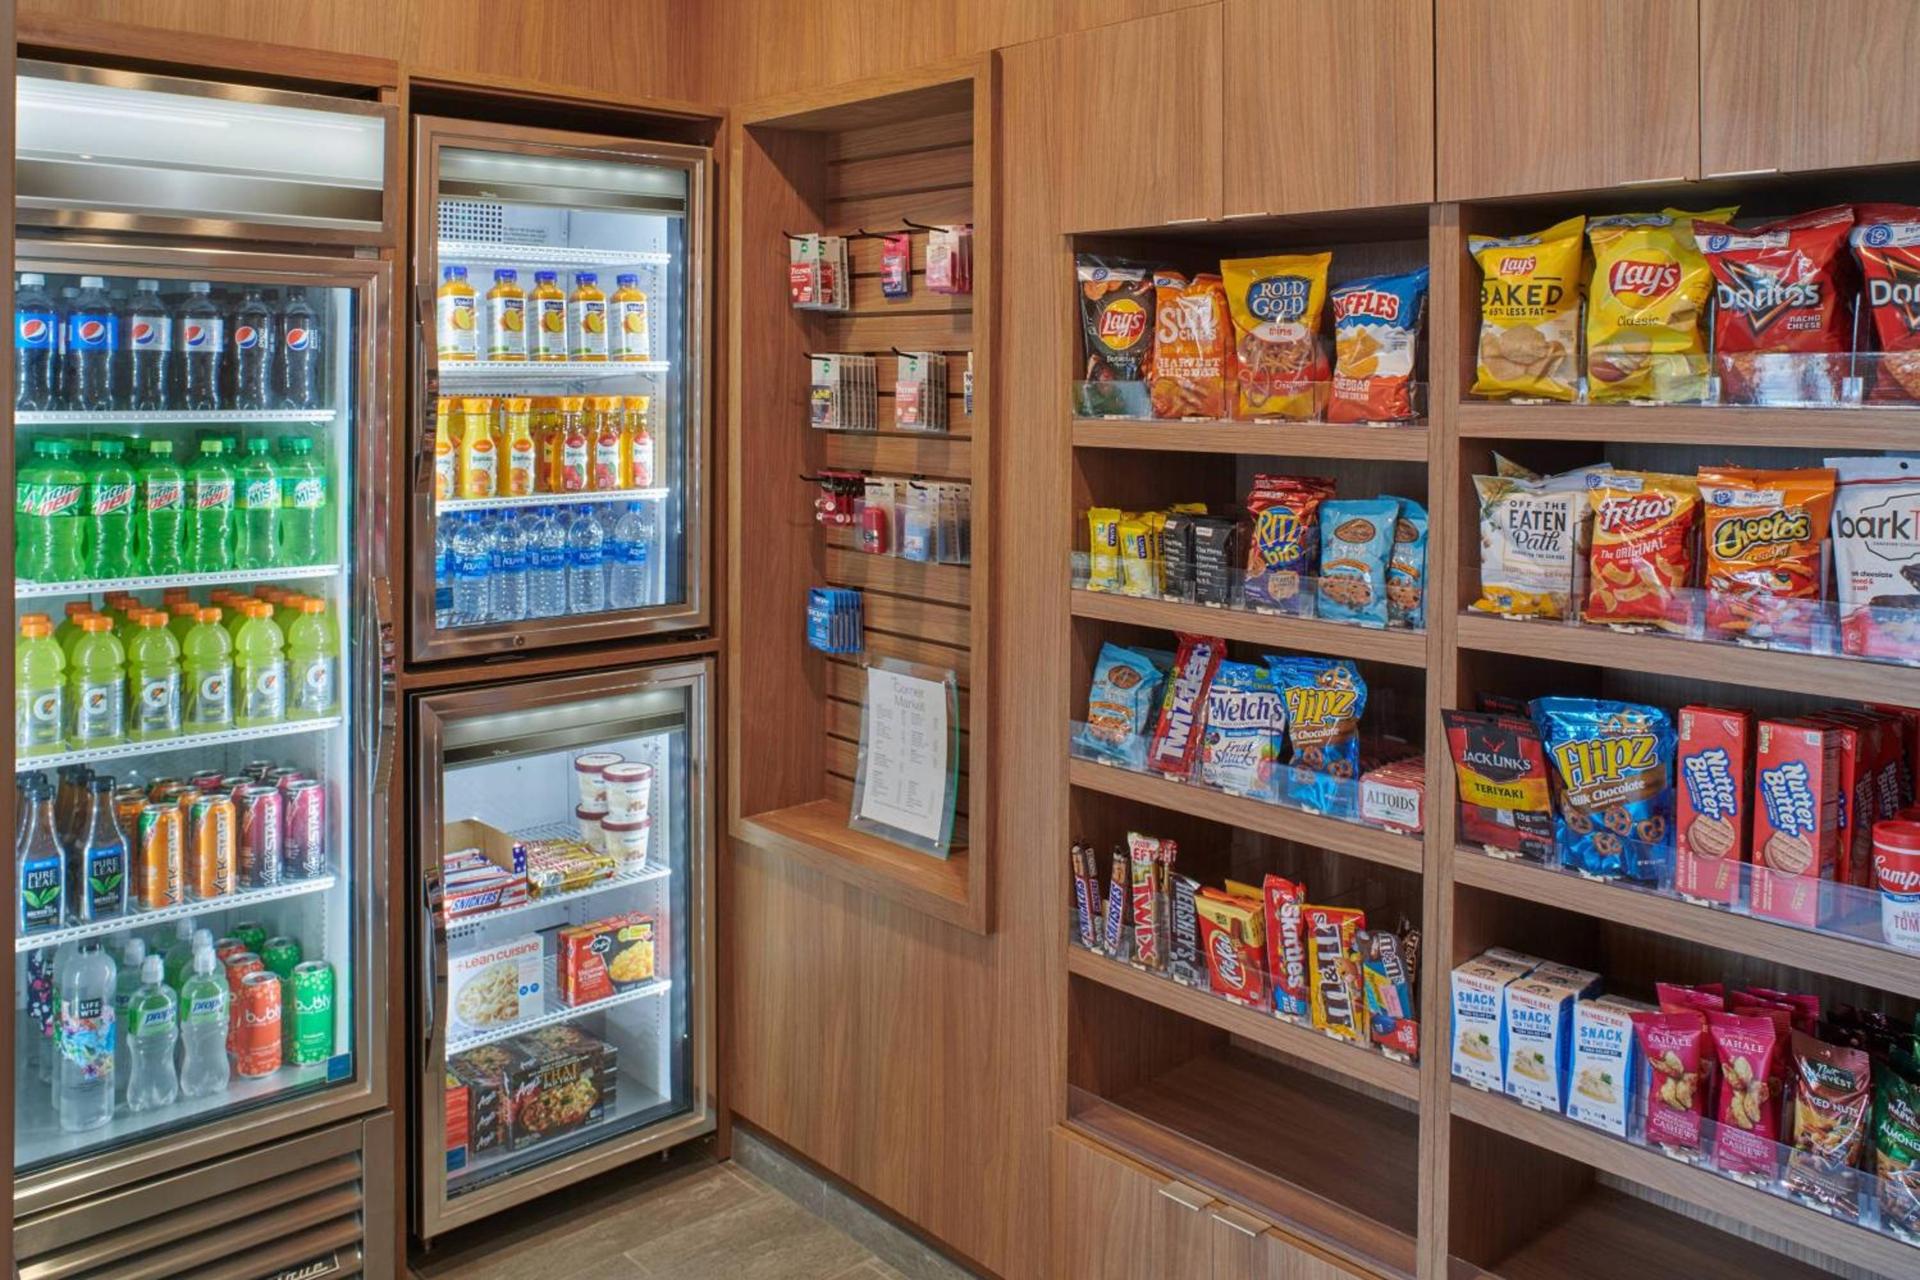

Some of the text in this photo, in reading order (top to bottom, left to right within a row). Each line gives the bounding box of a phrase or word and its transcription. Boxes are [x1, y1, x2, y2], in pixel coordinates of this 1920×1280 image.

[1500, 256, 1536, 275] Lay's
[1260, 280, 1305, 298] ROLD
[1614, 261, 1679, 296] Lay's
[1480, 284, 1563, 306] BAKED
[1717, 282, 1820, 309] Doritos
[1252, 296, 1304, 317] GOLD
[1506, 308, 1526, 316] LESS
[1529, 307, 1545, 316] FAT
[1102, 311, 1143, 336] Lay's
[1787, 322, 1822, 330] CHEESE
[1788, 314, 1821, 322] NACHO
[1509, 499, 1567, 510] OFF THE
[1599, 496, 1676, 532] Fritos
[1256, 510, 1300, 546] RITZ
[1509, 510, 1567, 532] EATEN
[1108, 523, 1117, 547] LUNA
[1512, 532, 1561, 552] Path
[1714, 509, 1811, 562] Cheetos
[1137, 535, 1147, 560] LUNA
[1209, 696, 1283, 722] Welch's
[1285, 688, 1358, 726] Flipz
[1463, 750, 1494, 765] JACK
[1554, 736, 1658, 796] Flipz
[1474, 782, 1524, 800] TERIYAKI
[1592, 779, 1646, 801] Chocolate
[1686, 757, 1720, 820] Butter
[1703, 749, 1735, 815] Nutter
[1366, 789, 1417, 812] ALTOIDS
[1764, 770, 1798, 836] Butter
[1782, 763, 1814, 831] Nutter
[93, 857, 119, 869] PURE
[27, 869, 56, 880] PURE
[452, 891, 499, 911] SNICKERS
[1132, 874, 1157, 961] TWIX
[1175, 880, 1197, 961] HERSHEY'S
[1280, 902, 1304, 989] Skittles
[1457, 991, 1496, 1007] SNACK
[1512, 1008, 1552, 1025] SNACK
[1580, 1026, 1623, 1043] SNACK
[1647, 1032, 1693, 1048] SAHALE
[1719, 1037, 1765, 1053] SAHALE
